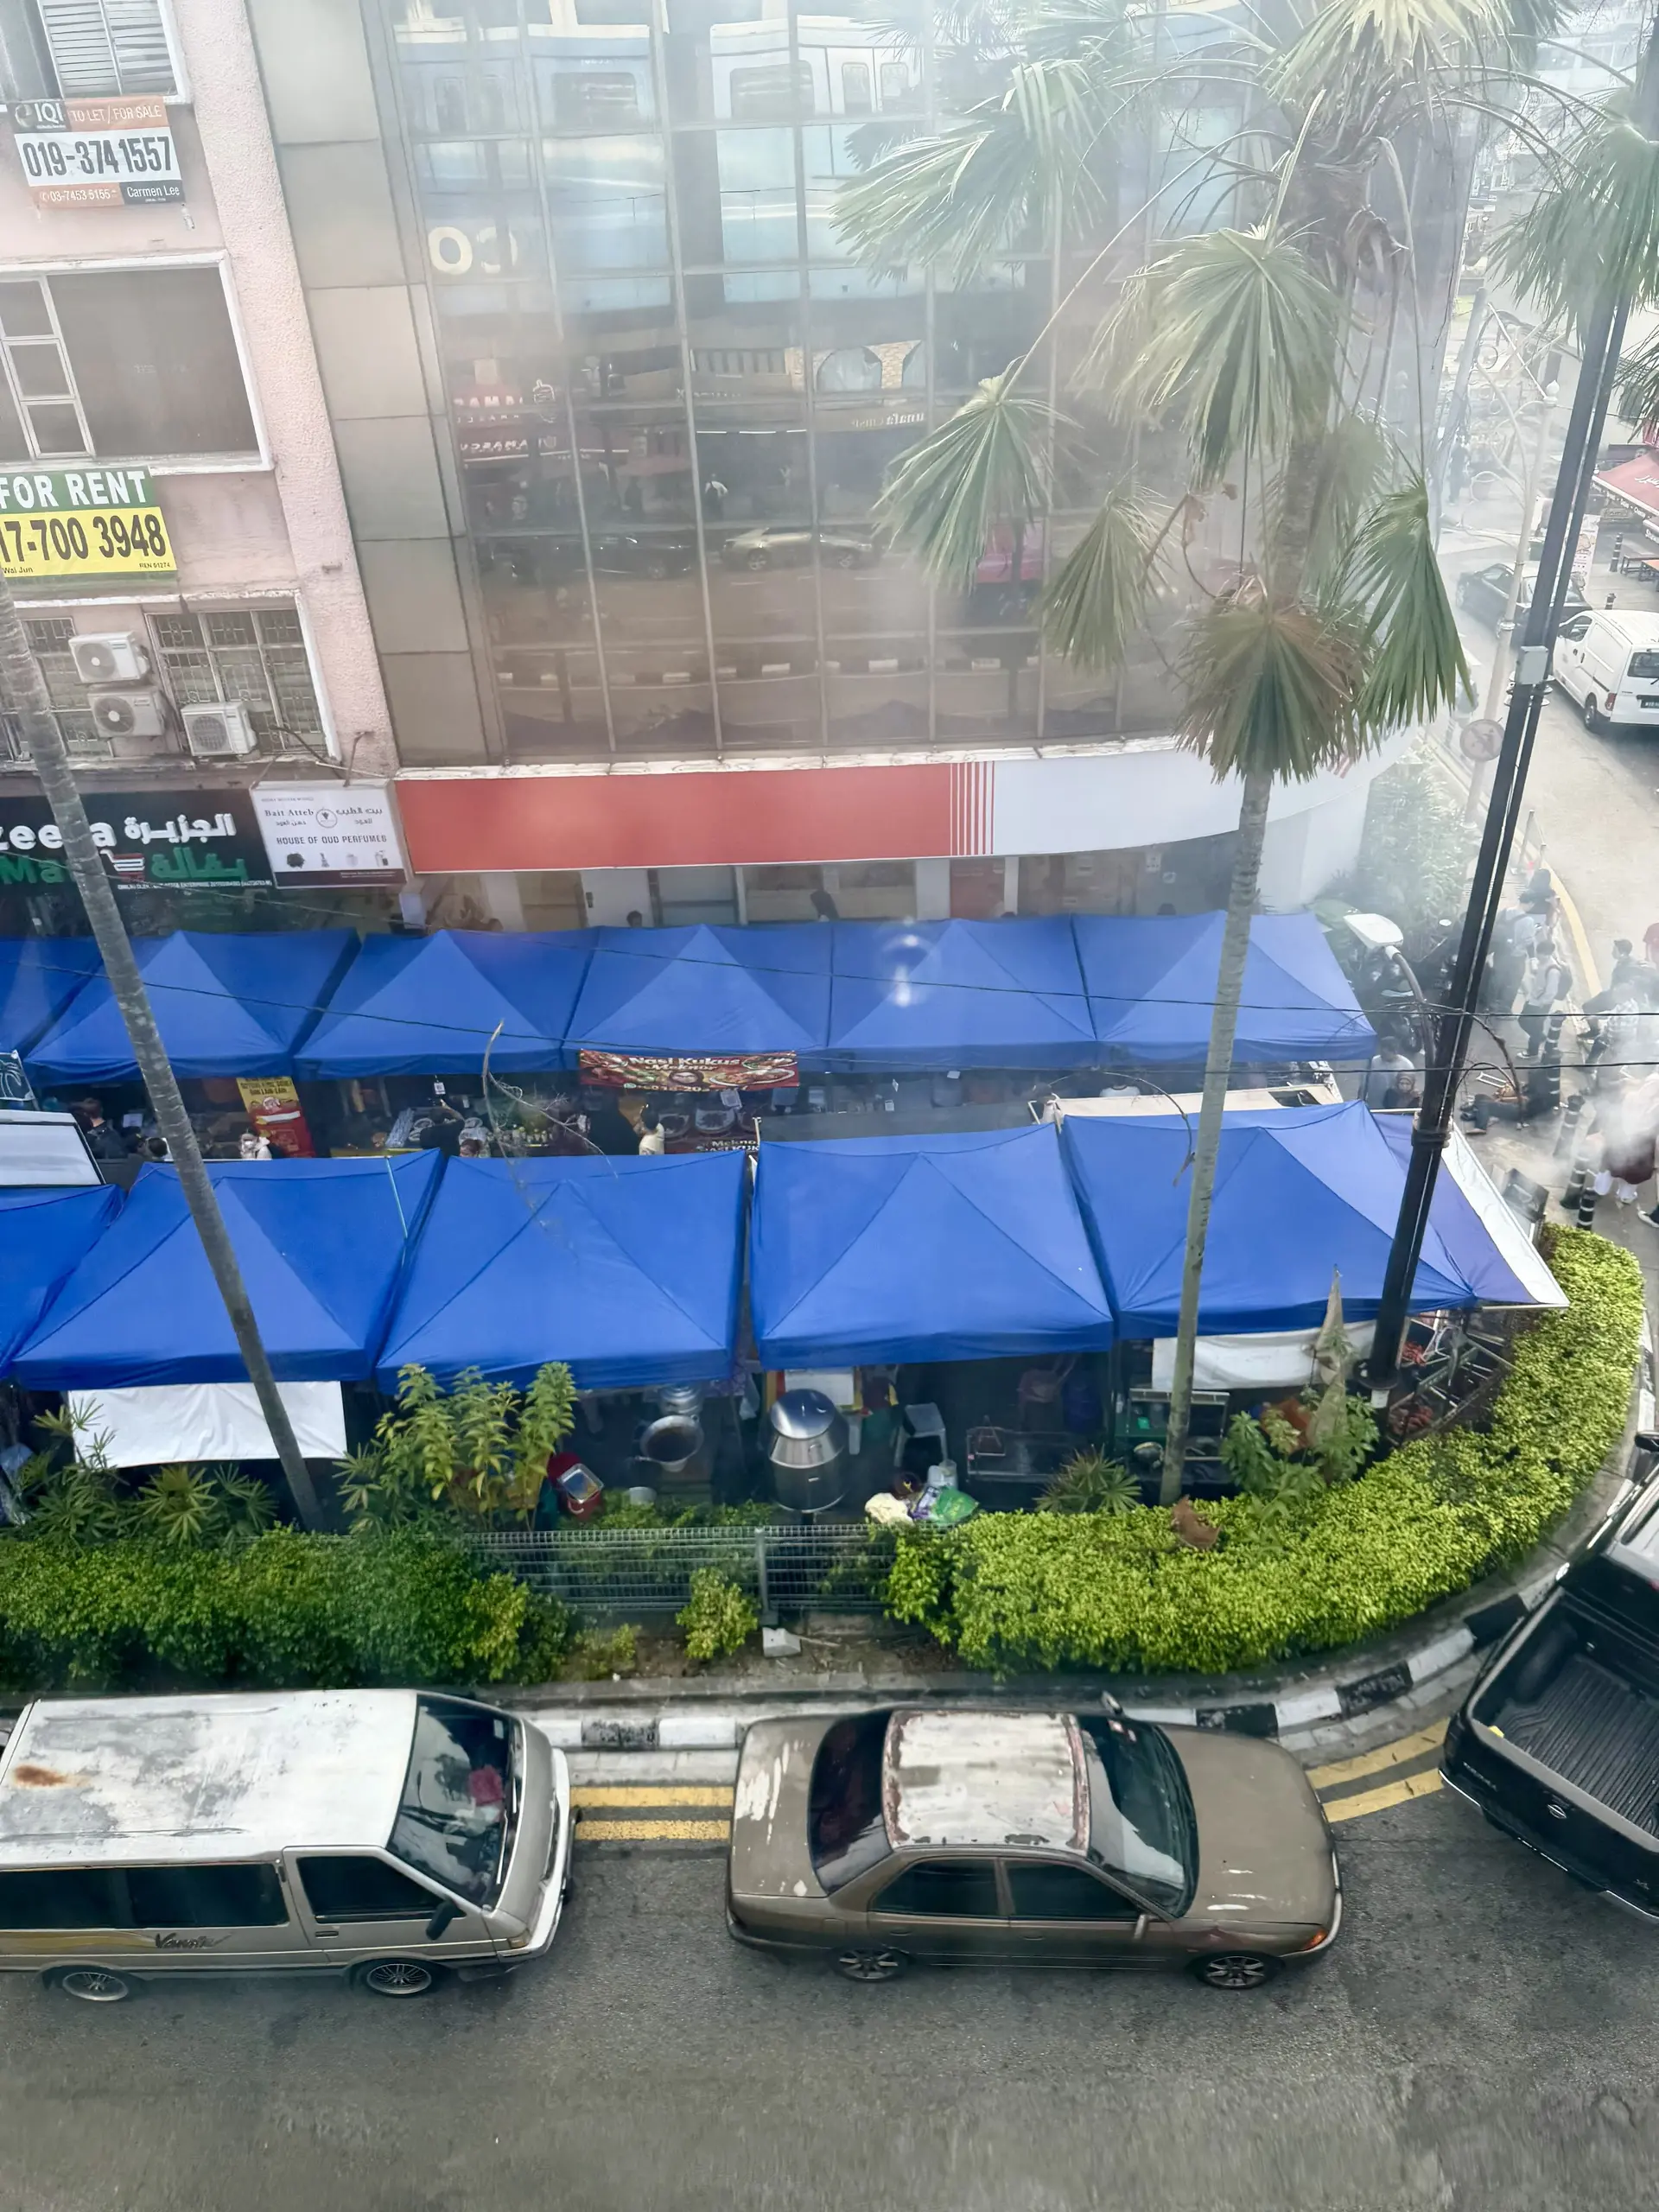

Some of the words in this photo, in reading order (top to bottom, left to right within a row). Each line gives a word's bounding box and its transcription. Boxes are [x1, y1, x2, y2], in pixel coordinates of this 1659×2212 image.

[34, 102, 64, 124] IQI
[87, 109, 105, 122] LET
[112, 107, 134, 120] FOR
[137, 105, 162, 118] SALE
[126, 185, 162, 198] Carmen
[163, 184, 180, 197] Lee
[0, 474, 59, 510] FOR
[65, 470, 146, 506] RENT
[92, 513, 166, 558] 3948
[342, 835, 387, 843] PERFUMES
